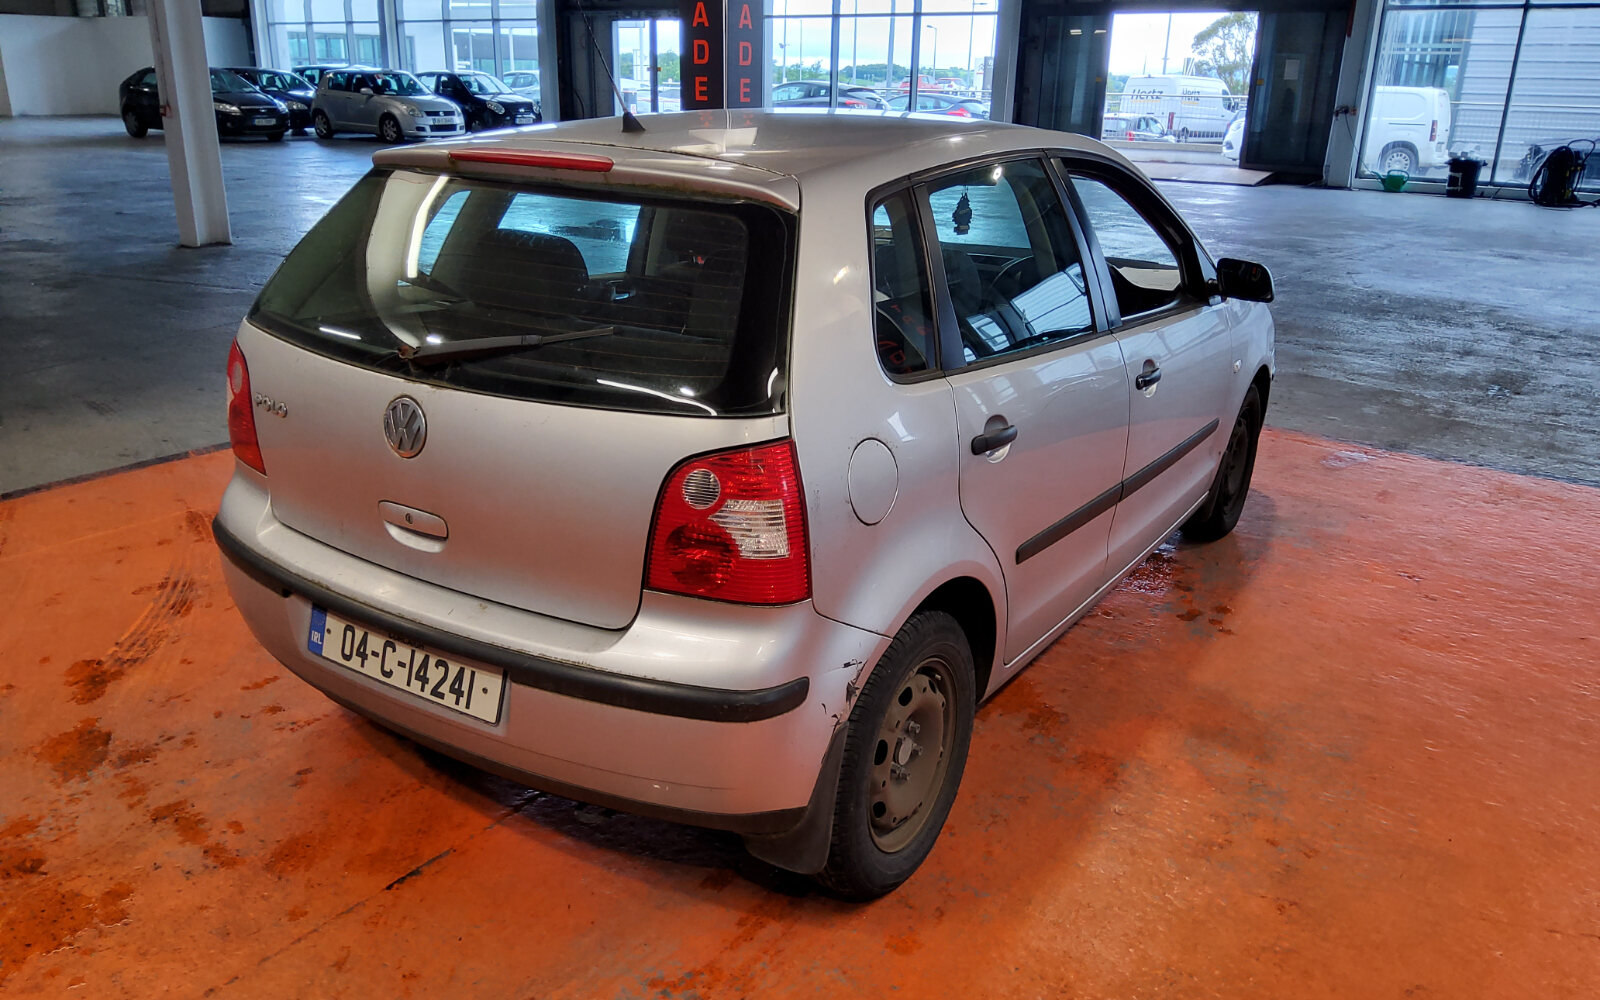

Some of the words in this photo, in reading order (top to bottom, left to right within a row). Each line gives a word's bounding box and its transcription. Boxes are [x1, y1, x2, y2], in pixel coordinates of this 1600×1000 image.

[1131, 88, 1163, 100] Hertz
[1181, 87, 1200, 101] Hertz
[255, 392, 288, 418] POLO
[311, 630, 322, 645] IRL
[341, 624, 476, 710] 04-C-14241
